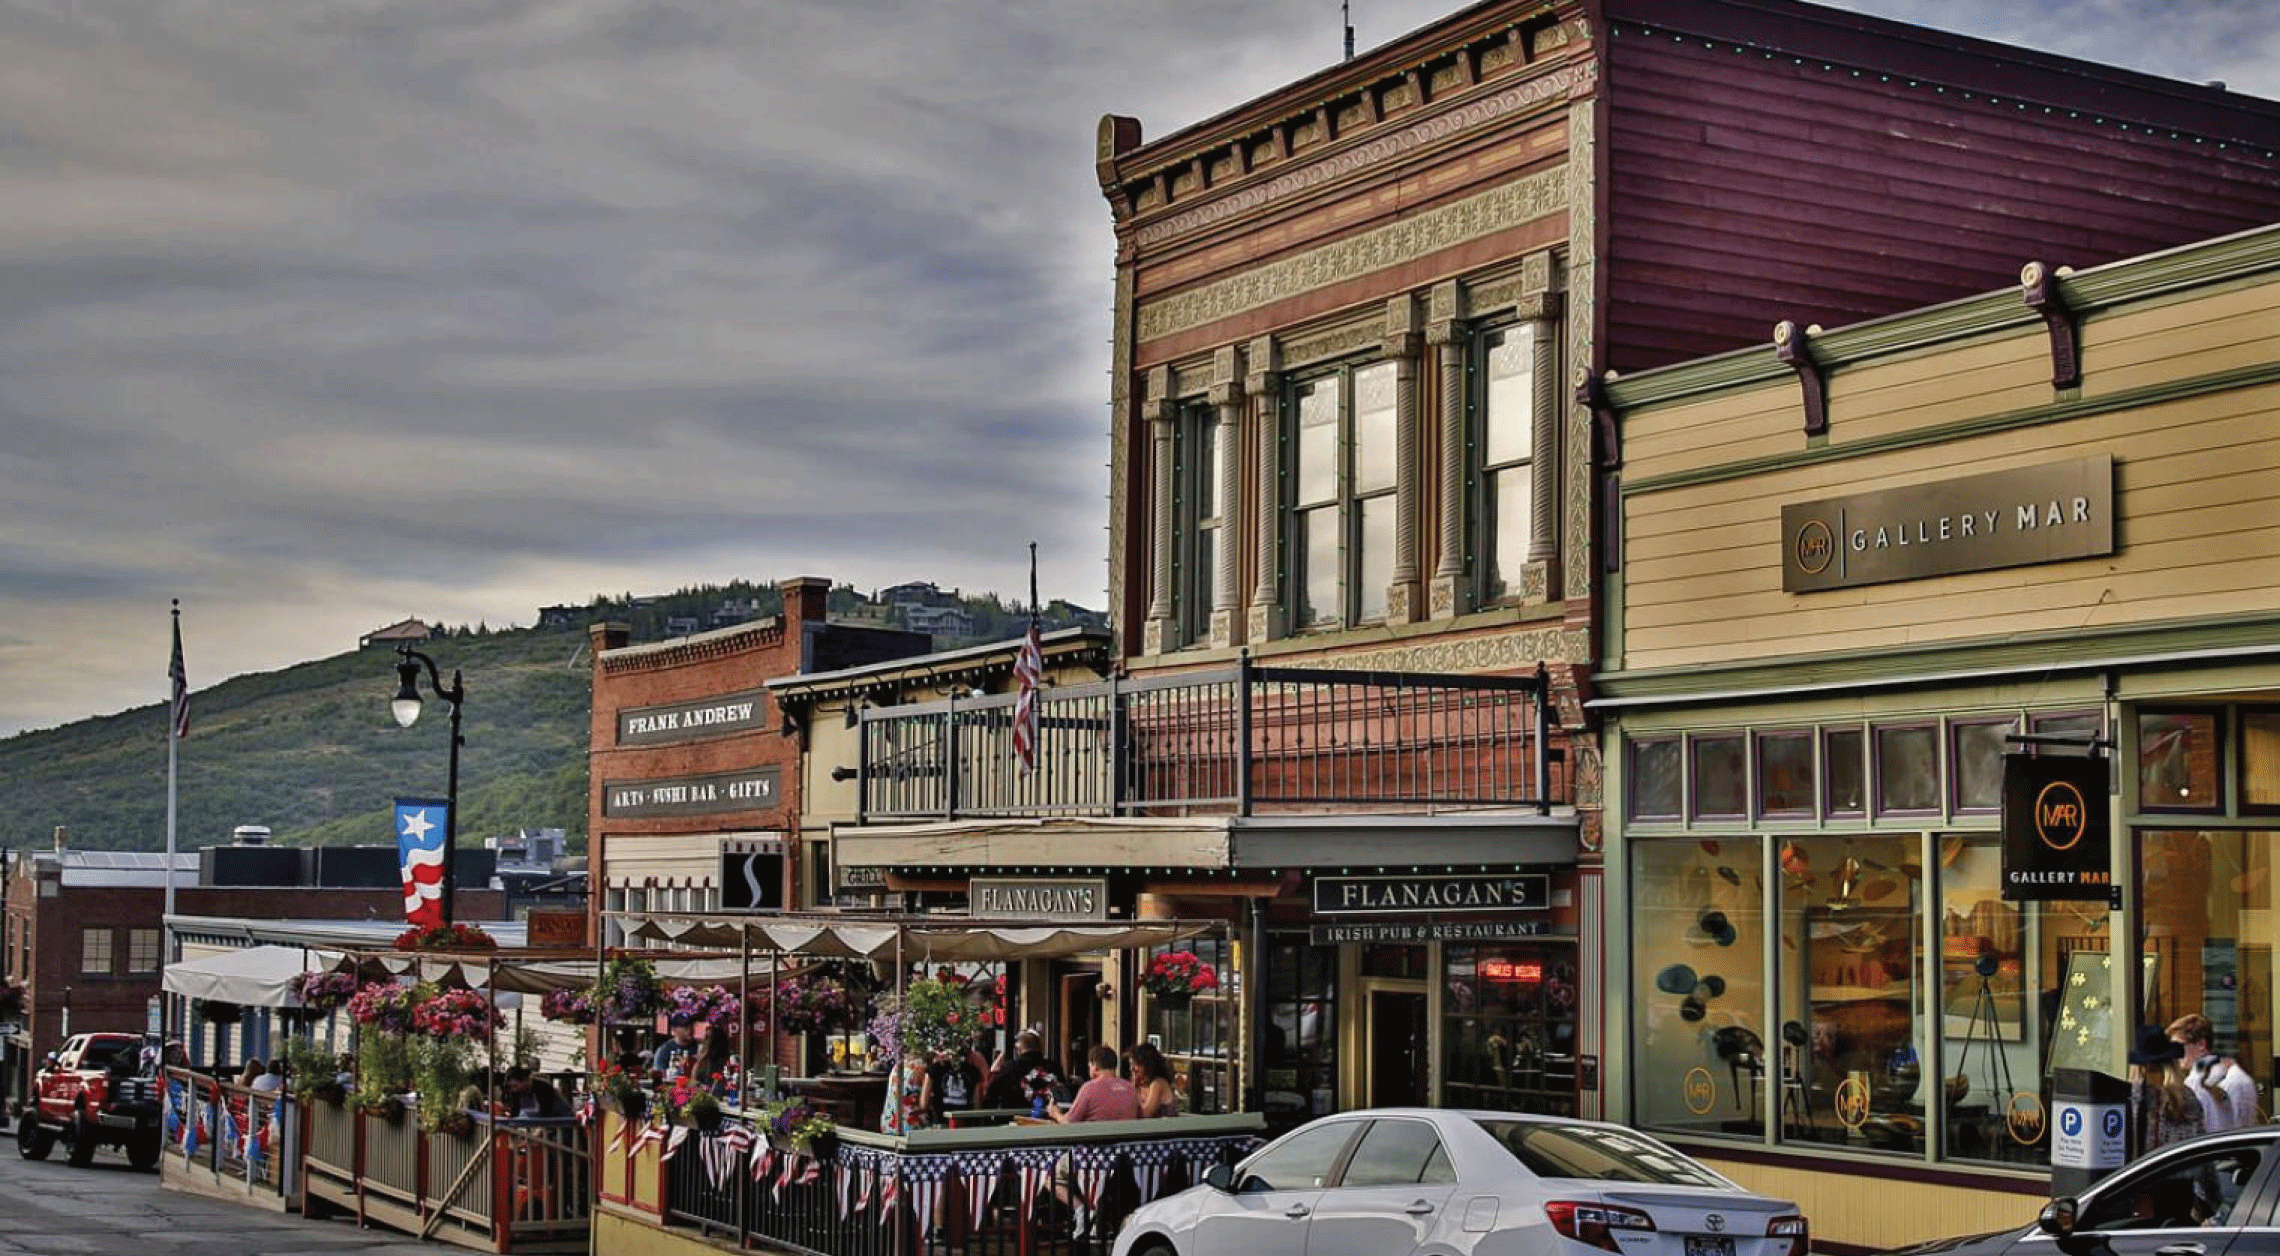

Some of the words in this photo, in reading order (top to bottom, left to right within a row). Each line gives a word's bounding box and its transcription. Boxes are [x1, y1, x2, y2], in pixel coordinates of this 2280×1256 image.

[1852, 510, 2000, 551] GALLERY
[2017, 497, 2090, 530] MAR
[628, 713, 679, 734] FRANK
[683, 703, 753, 728] ANDREW
[613, 790, 644, 807] ARTS
[653, 786, 688, 804] SUSHI
[692, 784, 717, 801] BAR
[729, 778, 770, 799] GIFTS
[2043, 804, 2078, 827] MAR
[2009, 871, 2075, 884] GALLERY
[2080, 871, 2109, 884] MAR
[981, 887, 1095, 913] FLANAGAN'S
[1341, 881, 1526, 907] FLANAGAN'S
[1327, 927, 1374, 941] IRISH
[1380, 926, 1412, 940] PUB
[1416, 926, 1427, 939] &
[1432, 922, 1539, 938] RESTAURANT
